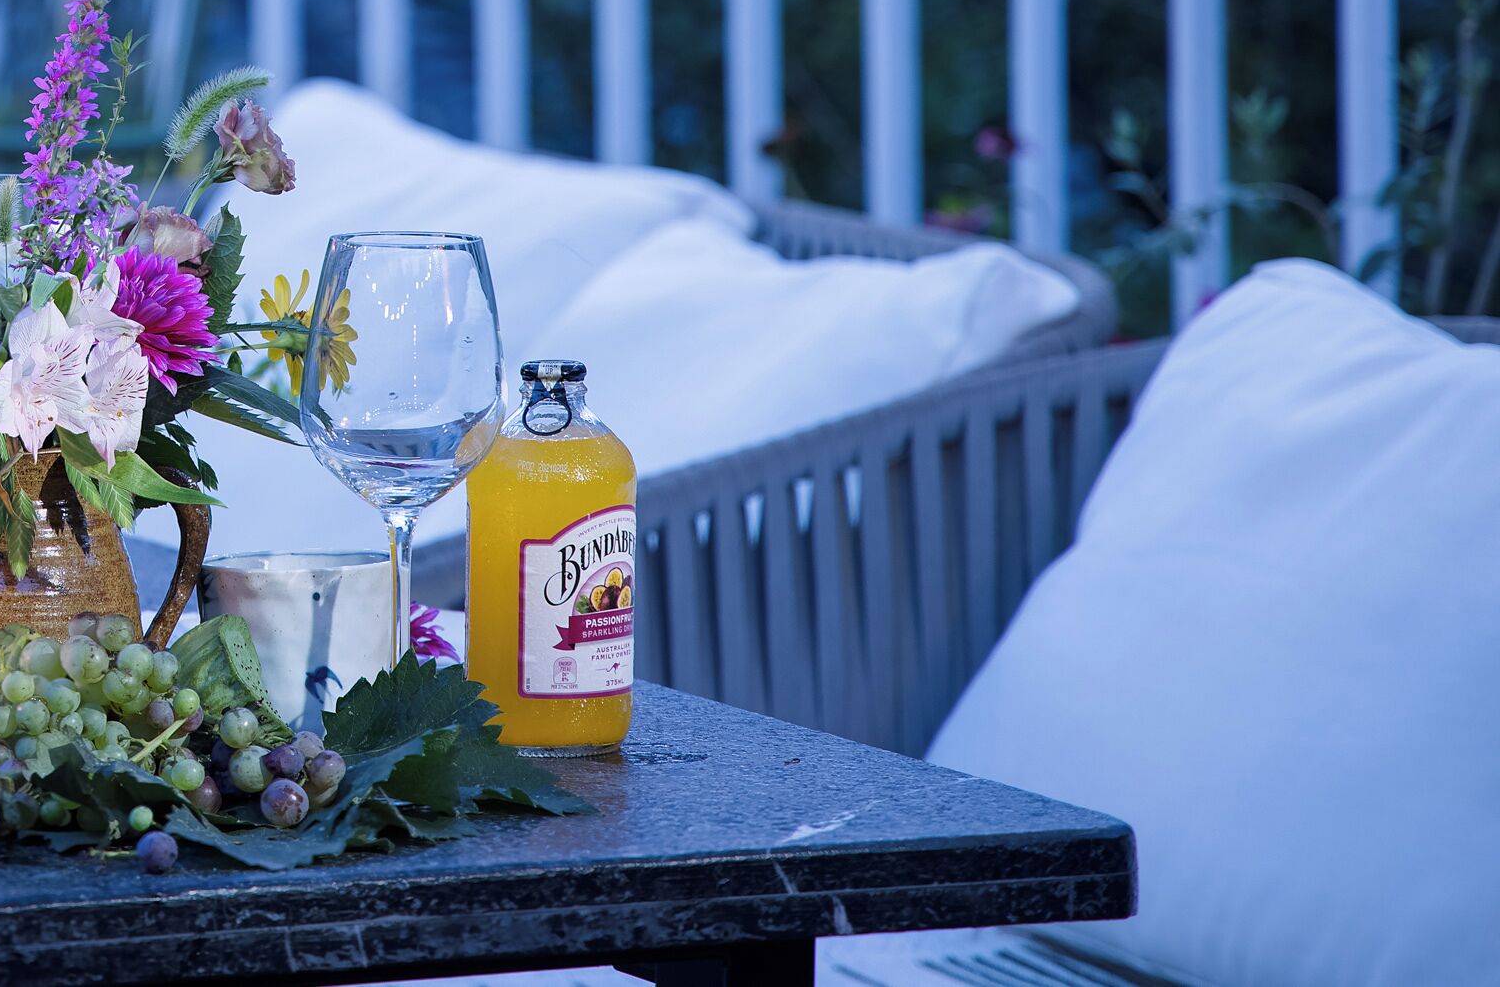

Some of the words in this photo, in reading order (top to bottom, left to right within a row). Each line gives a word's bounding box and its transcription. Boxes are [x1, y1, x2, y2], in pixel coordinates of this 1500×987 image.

[543, 524, 636, 607] BUNDABE
[581, 626, 623, 639] SPARKLING
[591, 653, 614, 662] FAMILY
